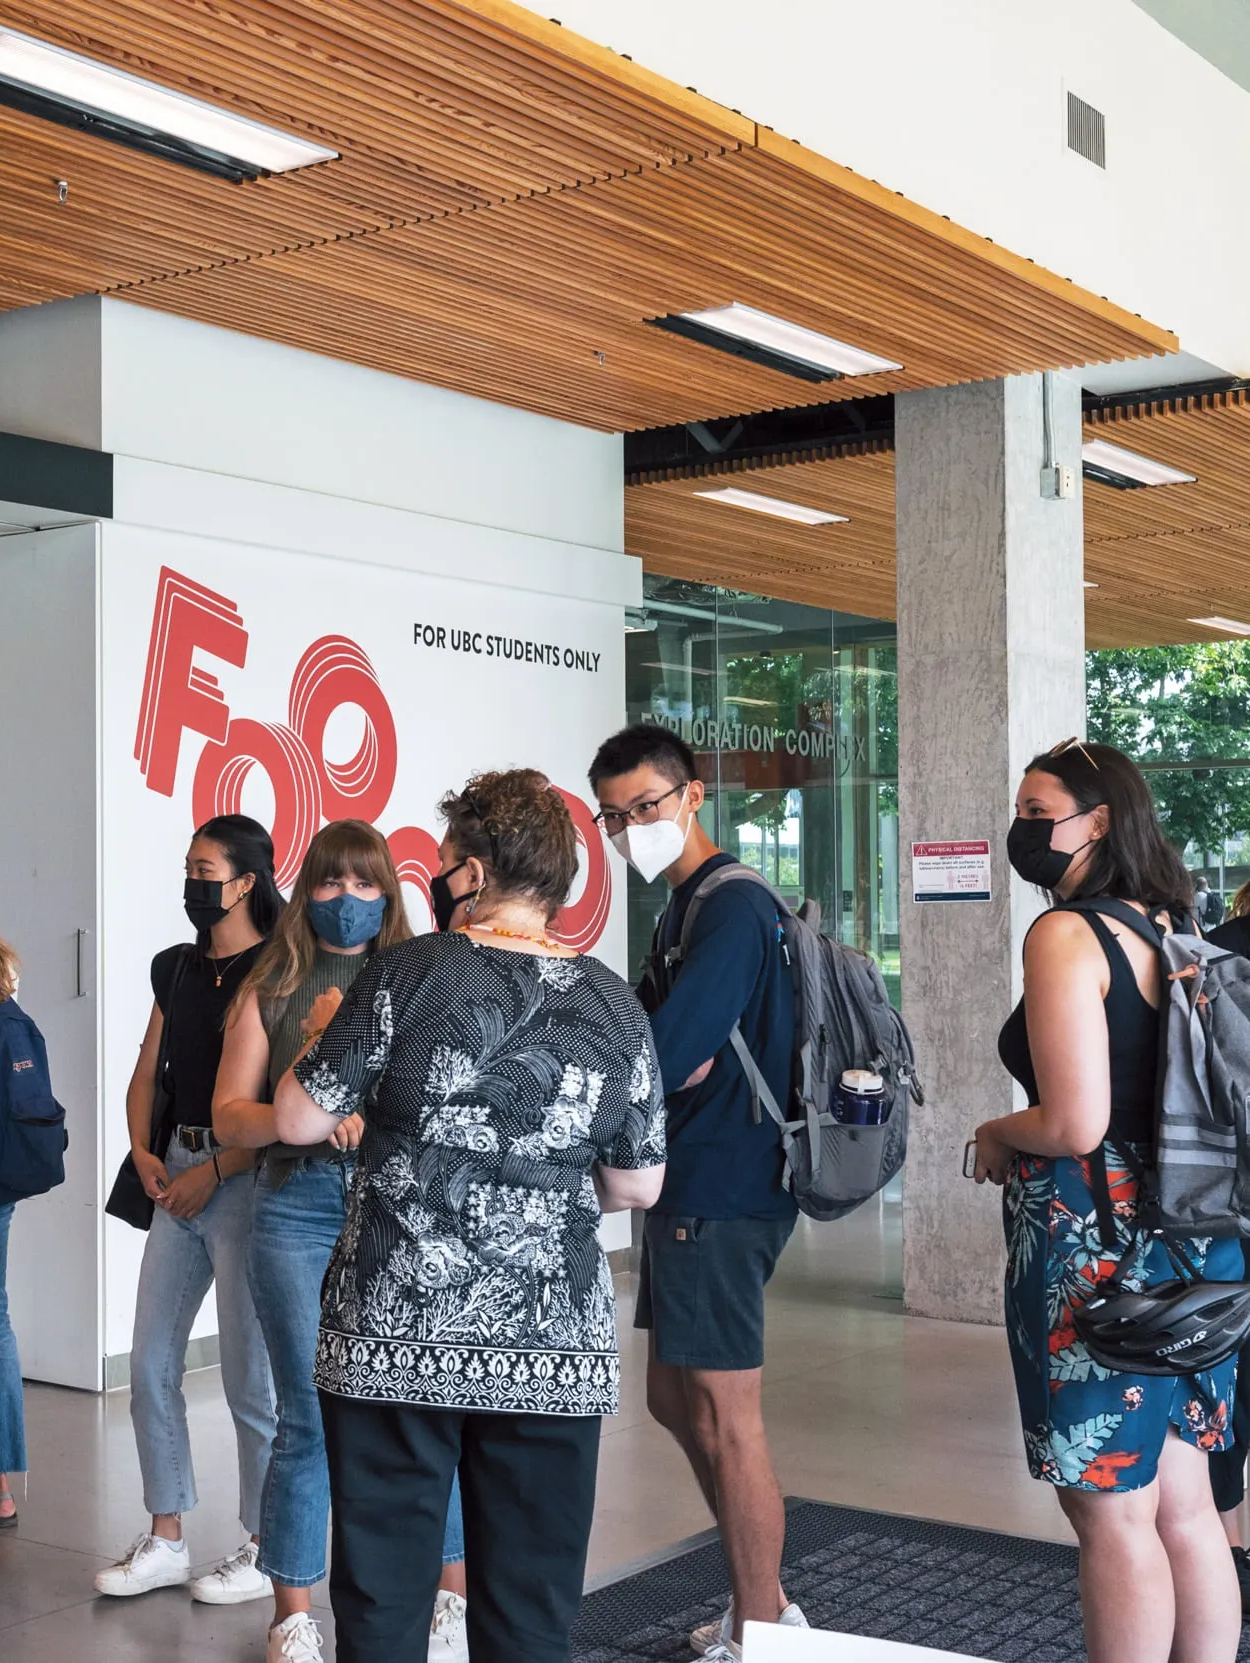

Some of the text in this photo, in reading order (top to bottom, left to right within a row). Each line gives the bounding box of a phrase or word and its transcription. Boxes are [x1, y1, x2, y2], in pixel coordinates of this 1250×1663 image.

[413, 622, 601, 673] FOR UBC STUDENTS ONLY
[1155, 1338, 1193, 1357] GIRO
